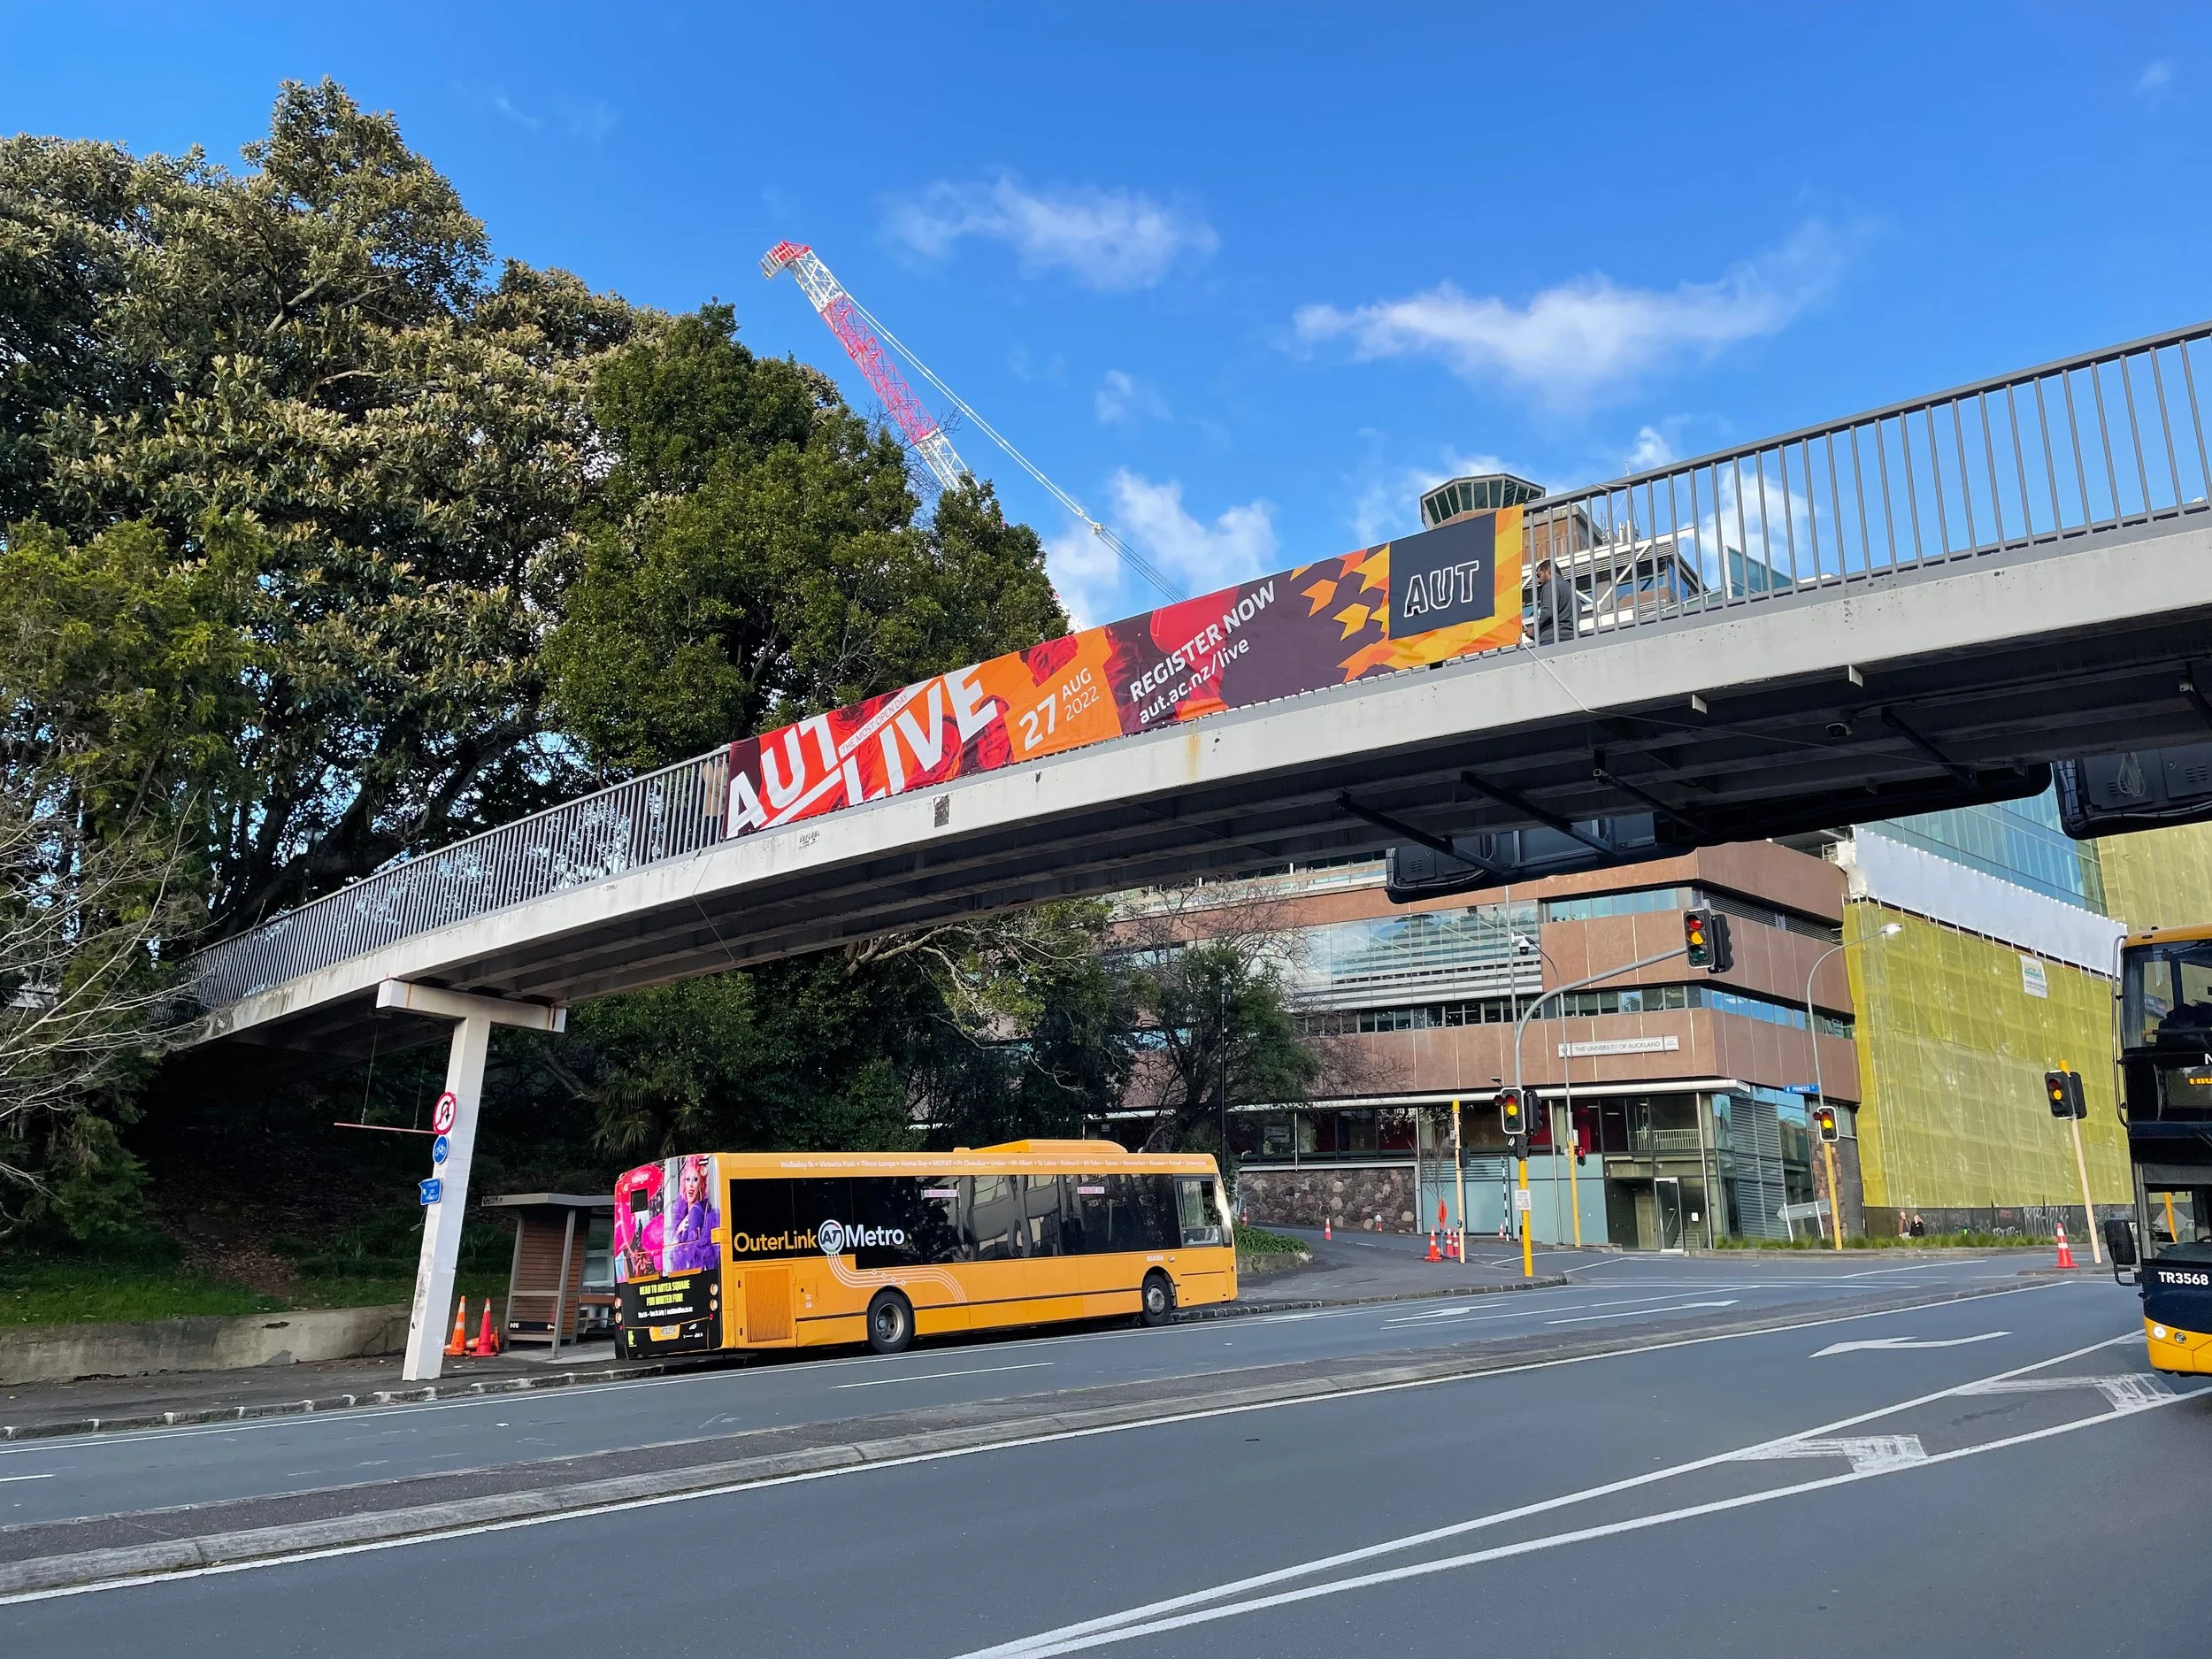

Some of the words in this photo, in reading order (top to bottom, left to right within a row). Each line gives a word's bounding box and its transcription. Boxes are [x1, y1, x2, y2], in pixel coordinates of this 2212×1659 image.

[1404, 560, 1479, 618] AUT
[1130, 623, 1223, 703] REGISTER
[1223, 580, 1274, 634] NOW
[1019, 694, 1056, 751] 27
[1062, 668, 1092, 701] AUG
[1064, 687, 1100, 721] 2022
[1140, 639, 1249, 724] aut.ac.nz/live
[841, 738, 855, 754] THE
[856, 722, 876, 741] MOST
[876, 706, 895, 725] OPEN
[895, 694, 908, 710] DAY
[843, 664, 998, 805] LIVE
[726, 713, 838, 839] AUT
[1575, 1044, 1586, 1053] THE
[1587, 1042, 1618, 1053] UNIVERSITY
[1628, 1041, 1660, 1049] AUCKLAND
[734, 1228, 818, 1252] OuterLink
[821, 1230, 841, 1244] AT
[846, 1225, 904, 1248] Metro
[651, 1285, 657, 1294] TO
[2158, 1271, 2208, 1285] TR3568
